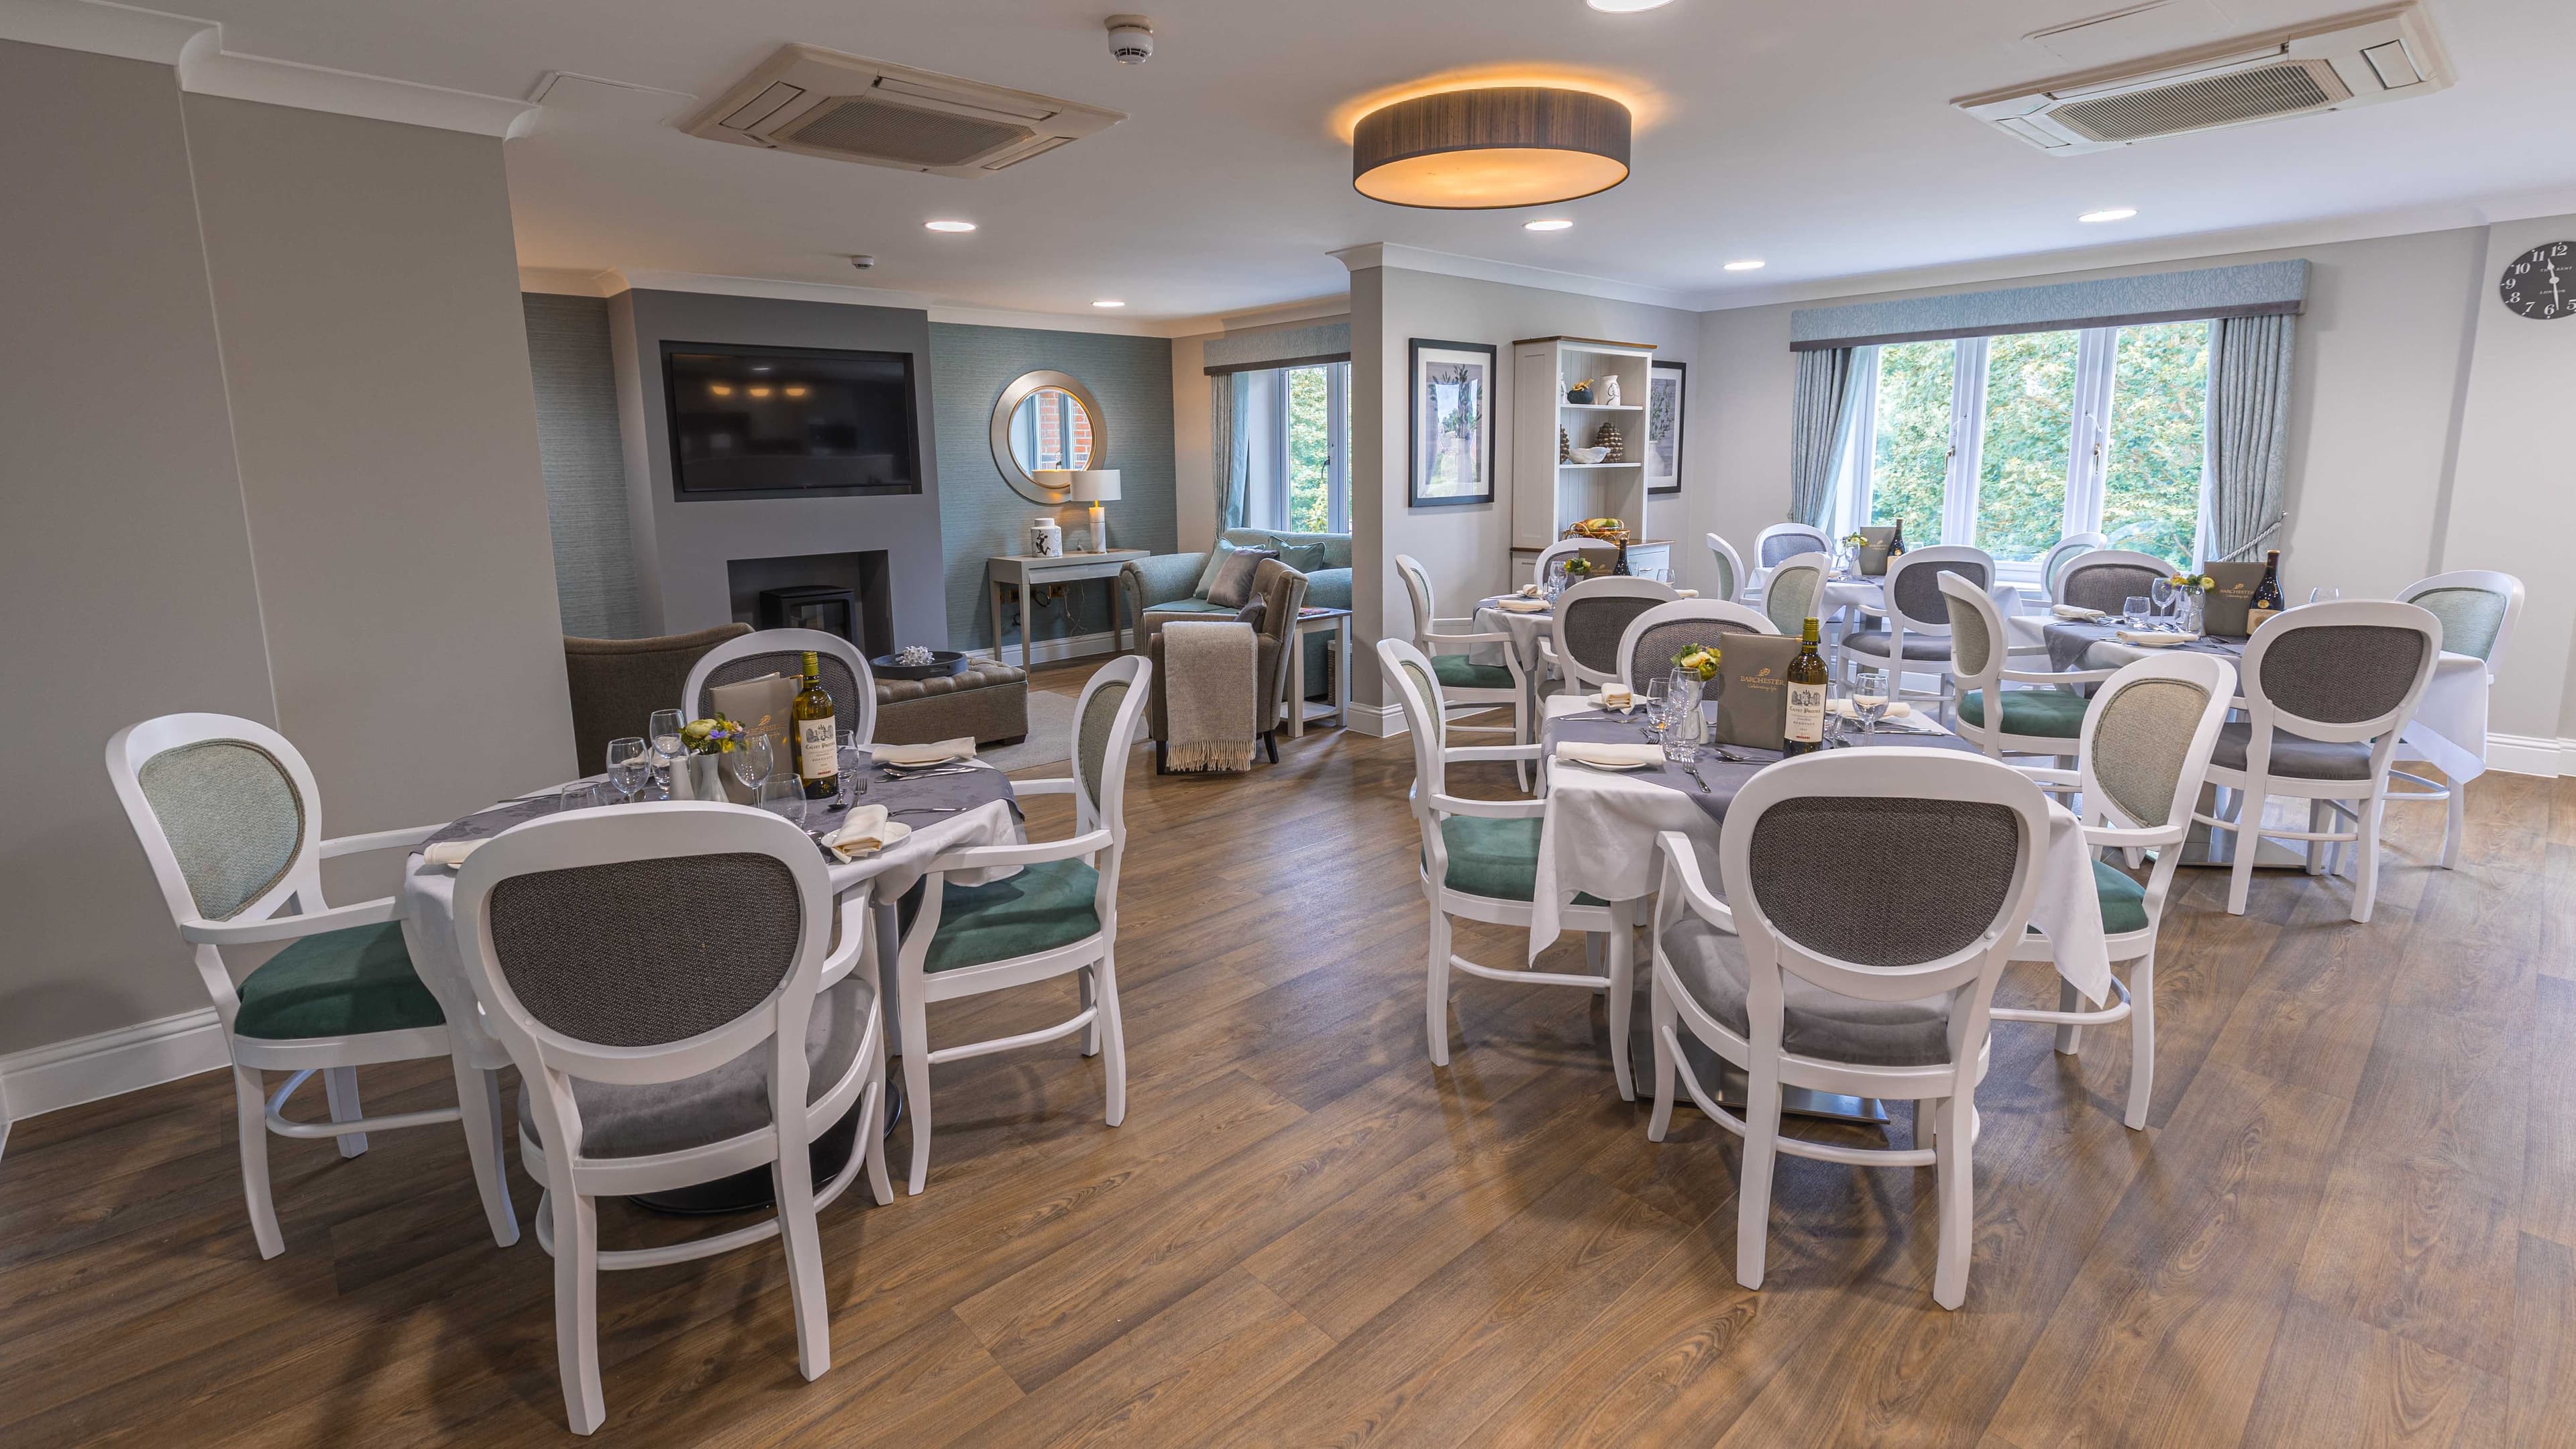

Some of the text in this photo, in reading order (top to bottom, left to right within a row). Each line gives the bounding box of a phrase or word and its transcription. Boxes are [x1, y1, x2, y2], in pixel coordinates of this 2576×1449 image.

[2532, 250, 2544, 262] 11
[2551, 245, 2567, 256] 12
[2515, 263, 2530, 274] 10
[2506, 278, 2516, 289] 9
[2510, 292, 2520, 303] 8
[2524, 301, 2536, 313] 7
[2544, 304, 2555, 315] 6
[1739, 676, 1786, 686] BARCHESTER
